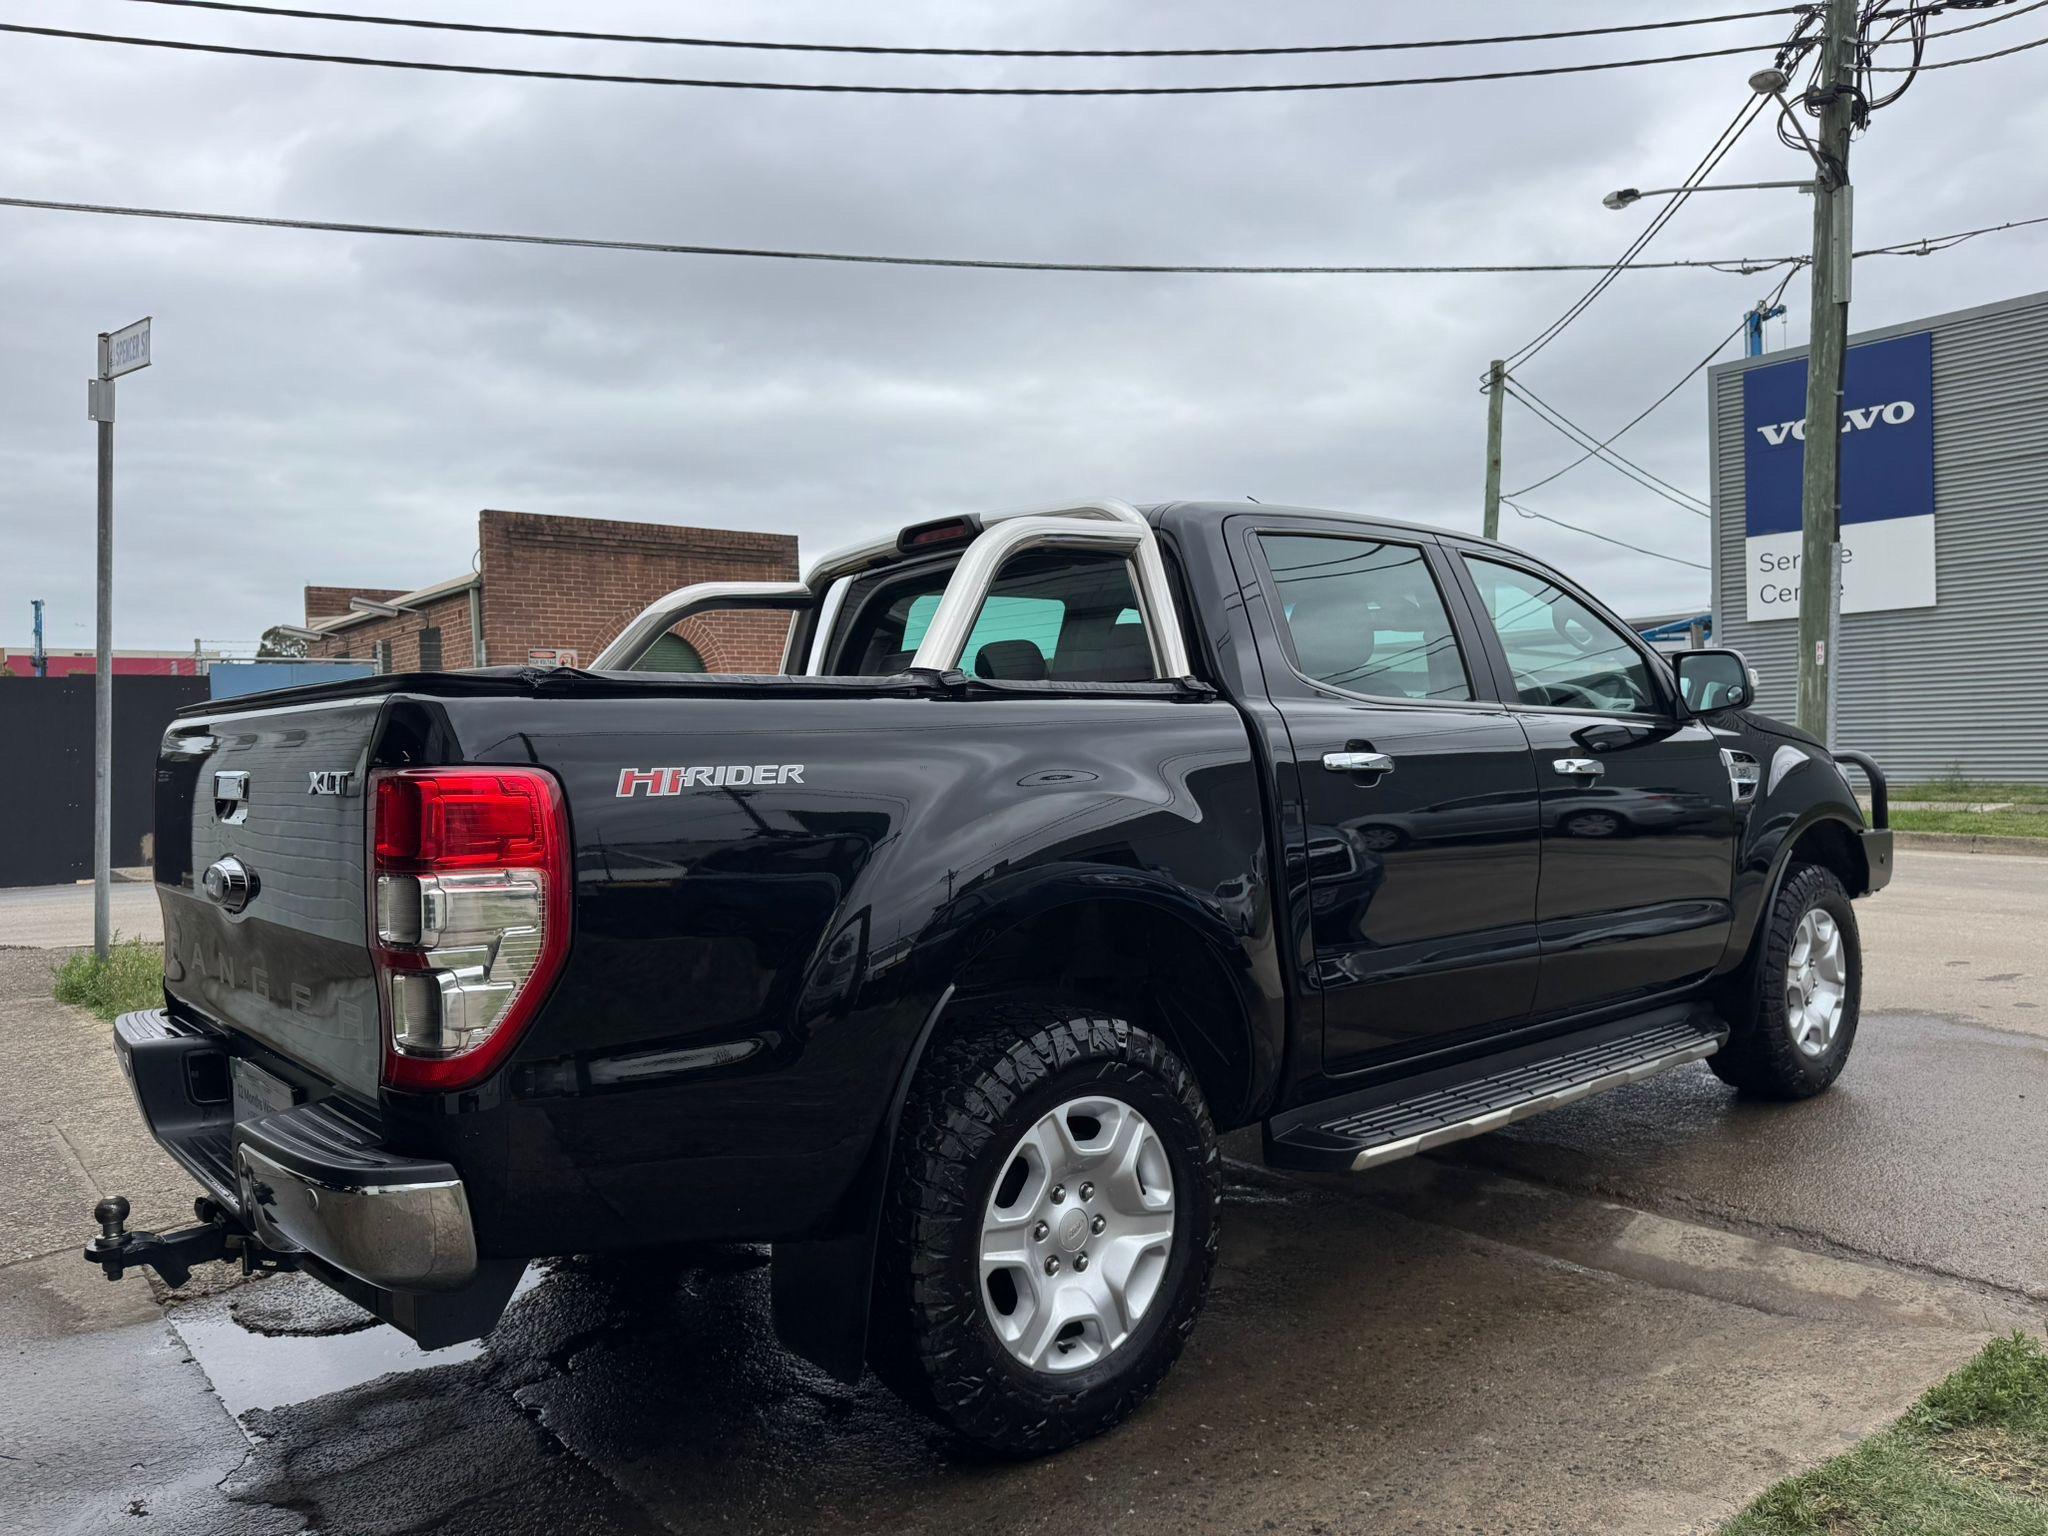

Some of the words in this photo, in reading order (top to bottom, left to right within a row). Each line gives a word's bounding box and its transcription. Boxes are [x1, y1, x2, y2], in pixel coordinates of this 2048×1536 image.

[116, 334, 140, 366] SPENCER
[141, 330, 149, 356] ST
[1757, 401, 1915, 446] VVO
[1759, 547, 1853, 573] Sere
[1760, 583, 1844, 605] Cen
[308, 771, 353, 795] XLT
[169, 929, 364, 1047] RANGER
